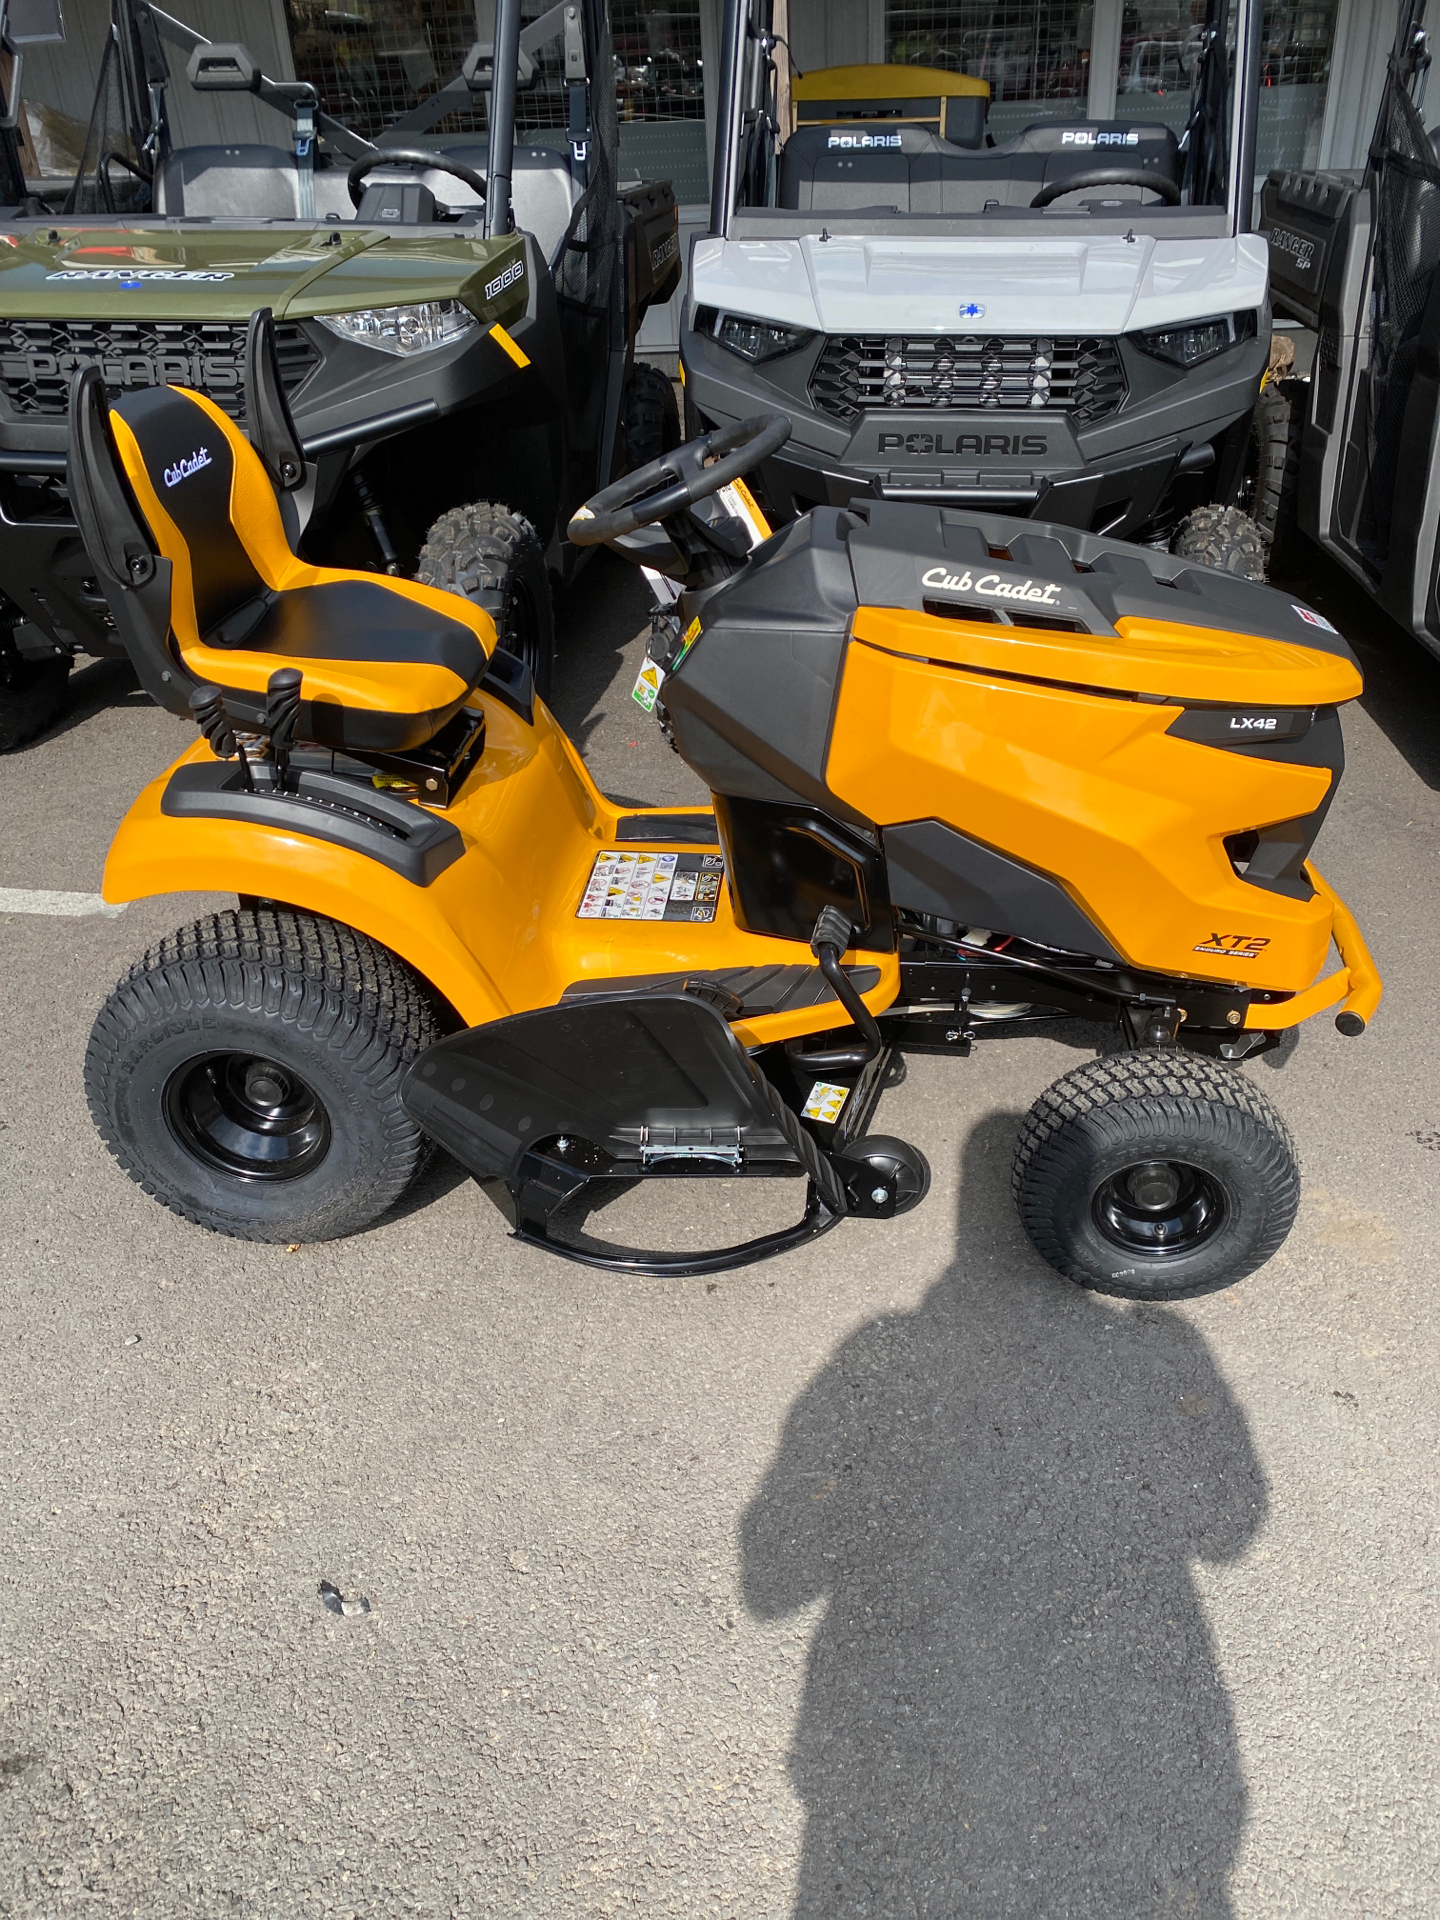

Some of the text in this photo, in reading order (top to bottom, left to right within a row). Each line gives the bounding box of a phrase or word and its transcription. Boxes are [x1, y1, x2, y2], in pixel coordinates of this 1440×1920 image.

[828, 135, 902, 148] POLARIS
[1062, 131, 1139, 145] POLARIS
[1270, 227, 1315, 261] RANGER
[1295, 257, 1311, 270] SP
[46, 270, 235, 281] RANGER
[484, 260, 524, 300] 1000
[26, 353, 239, 387] POLARIS
[878, 433, 1048, 456] POLARIS
[164, 446, 213, 487] Cub Cadet
[921, 567, 1062, 605] Cub Cadet
[1229, 717, 1278, 730] LX42
[1194, 946, 1227, 954] ENDURO
[1199, 932, 1272, 951] XT2
[121, 1016, 217, 1075] CARLISLE
